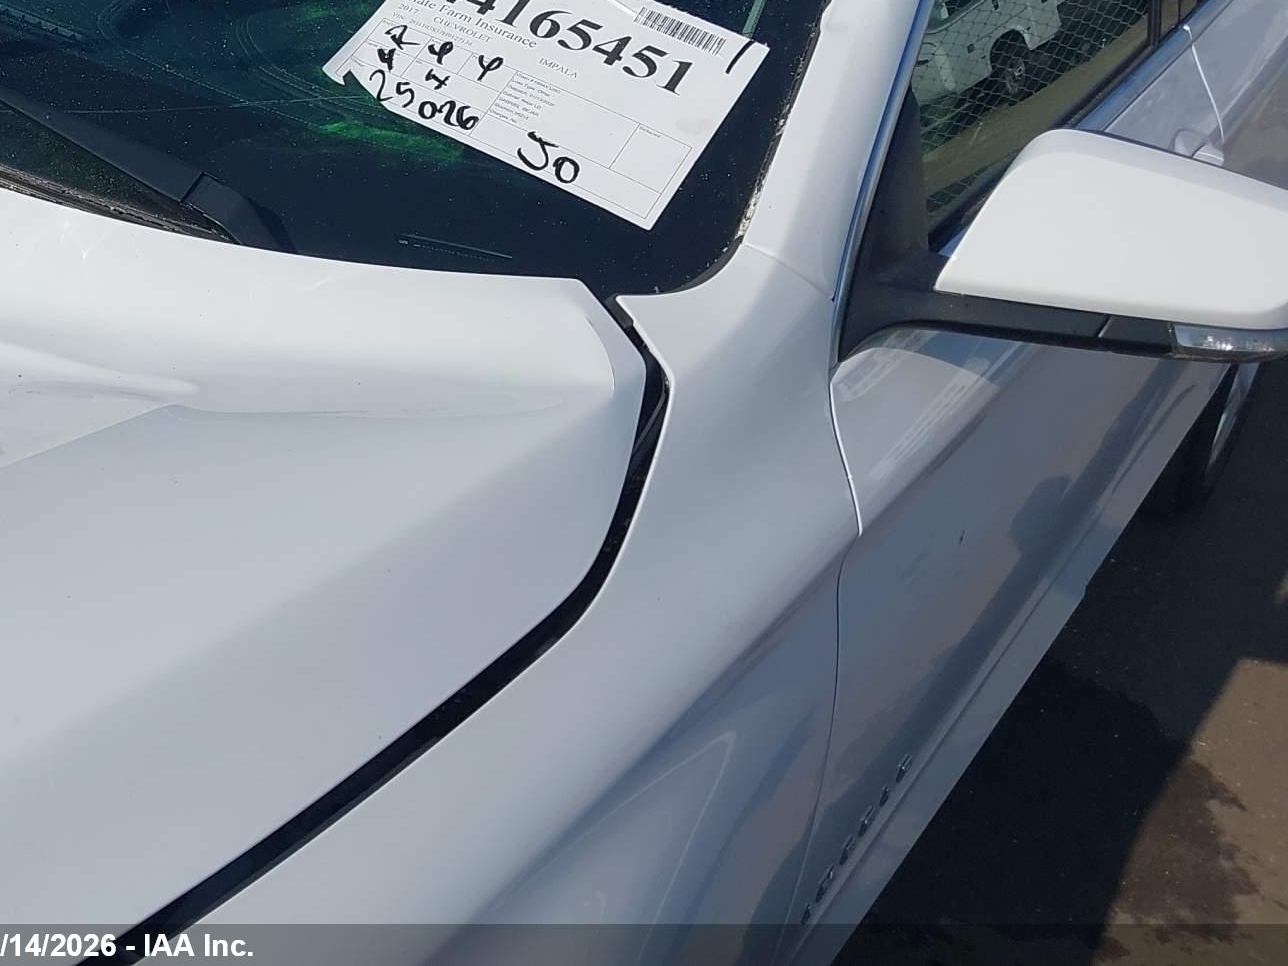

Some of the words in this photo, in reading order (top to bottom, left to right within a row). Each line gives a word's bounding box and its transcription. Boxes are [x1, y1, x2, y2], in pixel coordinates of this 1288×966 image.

[397, 3, 420, 16] 2017
[433, 16, 493, 44] CHEVROLET
[538, 57, 579, 79] IMPALA
[439, 3, 472, 24] Farm
[475, 17, 538, 49] Insurance
